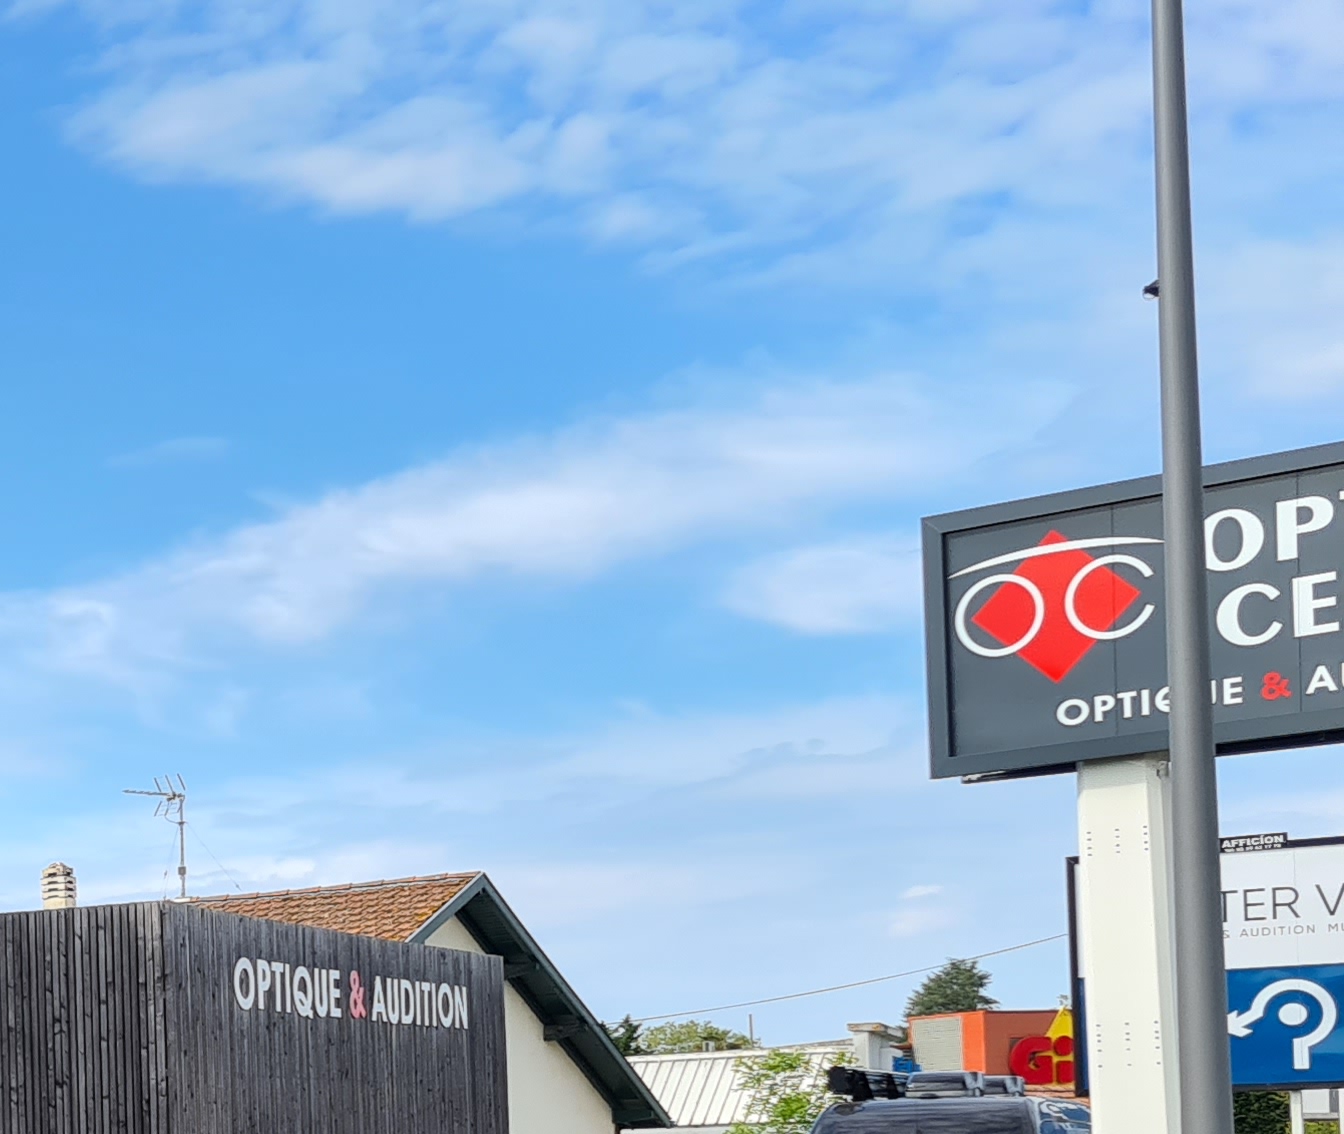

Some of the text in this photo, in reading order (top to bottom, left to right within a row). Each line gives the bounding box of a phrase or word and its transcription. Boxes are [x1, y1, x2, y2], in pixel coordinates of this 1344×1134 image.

[1204, 490, 1344, 573] OP
[1055, 663, 1344, 727] OPTIE & A
[1239, 924, 1316, 938] AUDITION
[1327, 922, 1344, 933] M
[233, 956, 469, 1030] OPTIQUE & AUDITION
